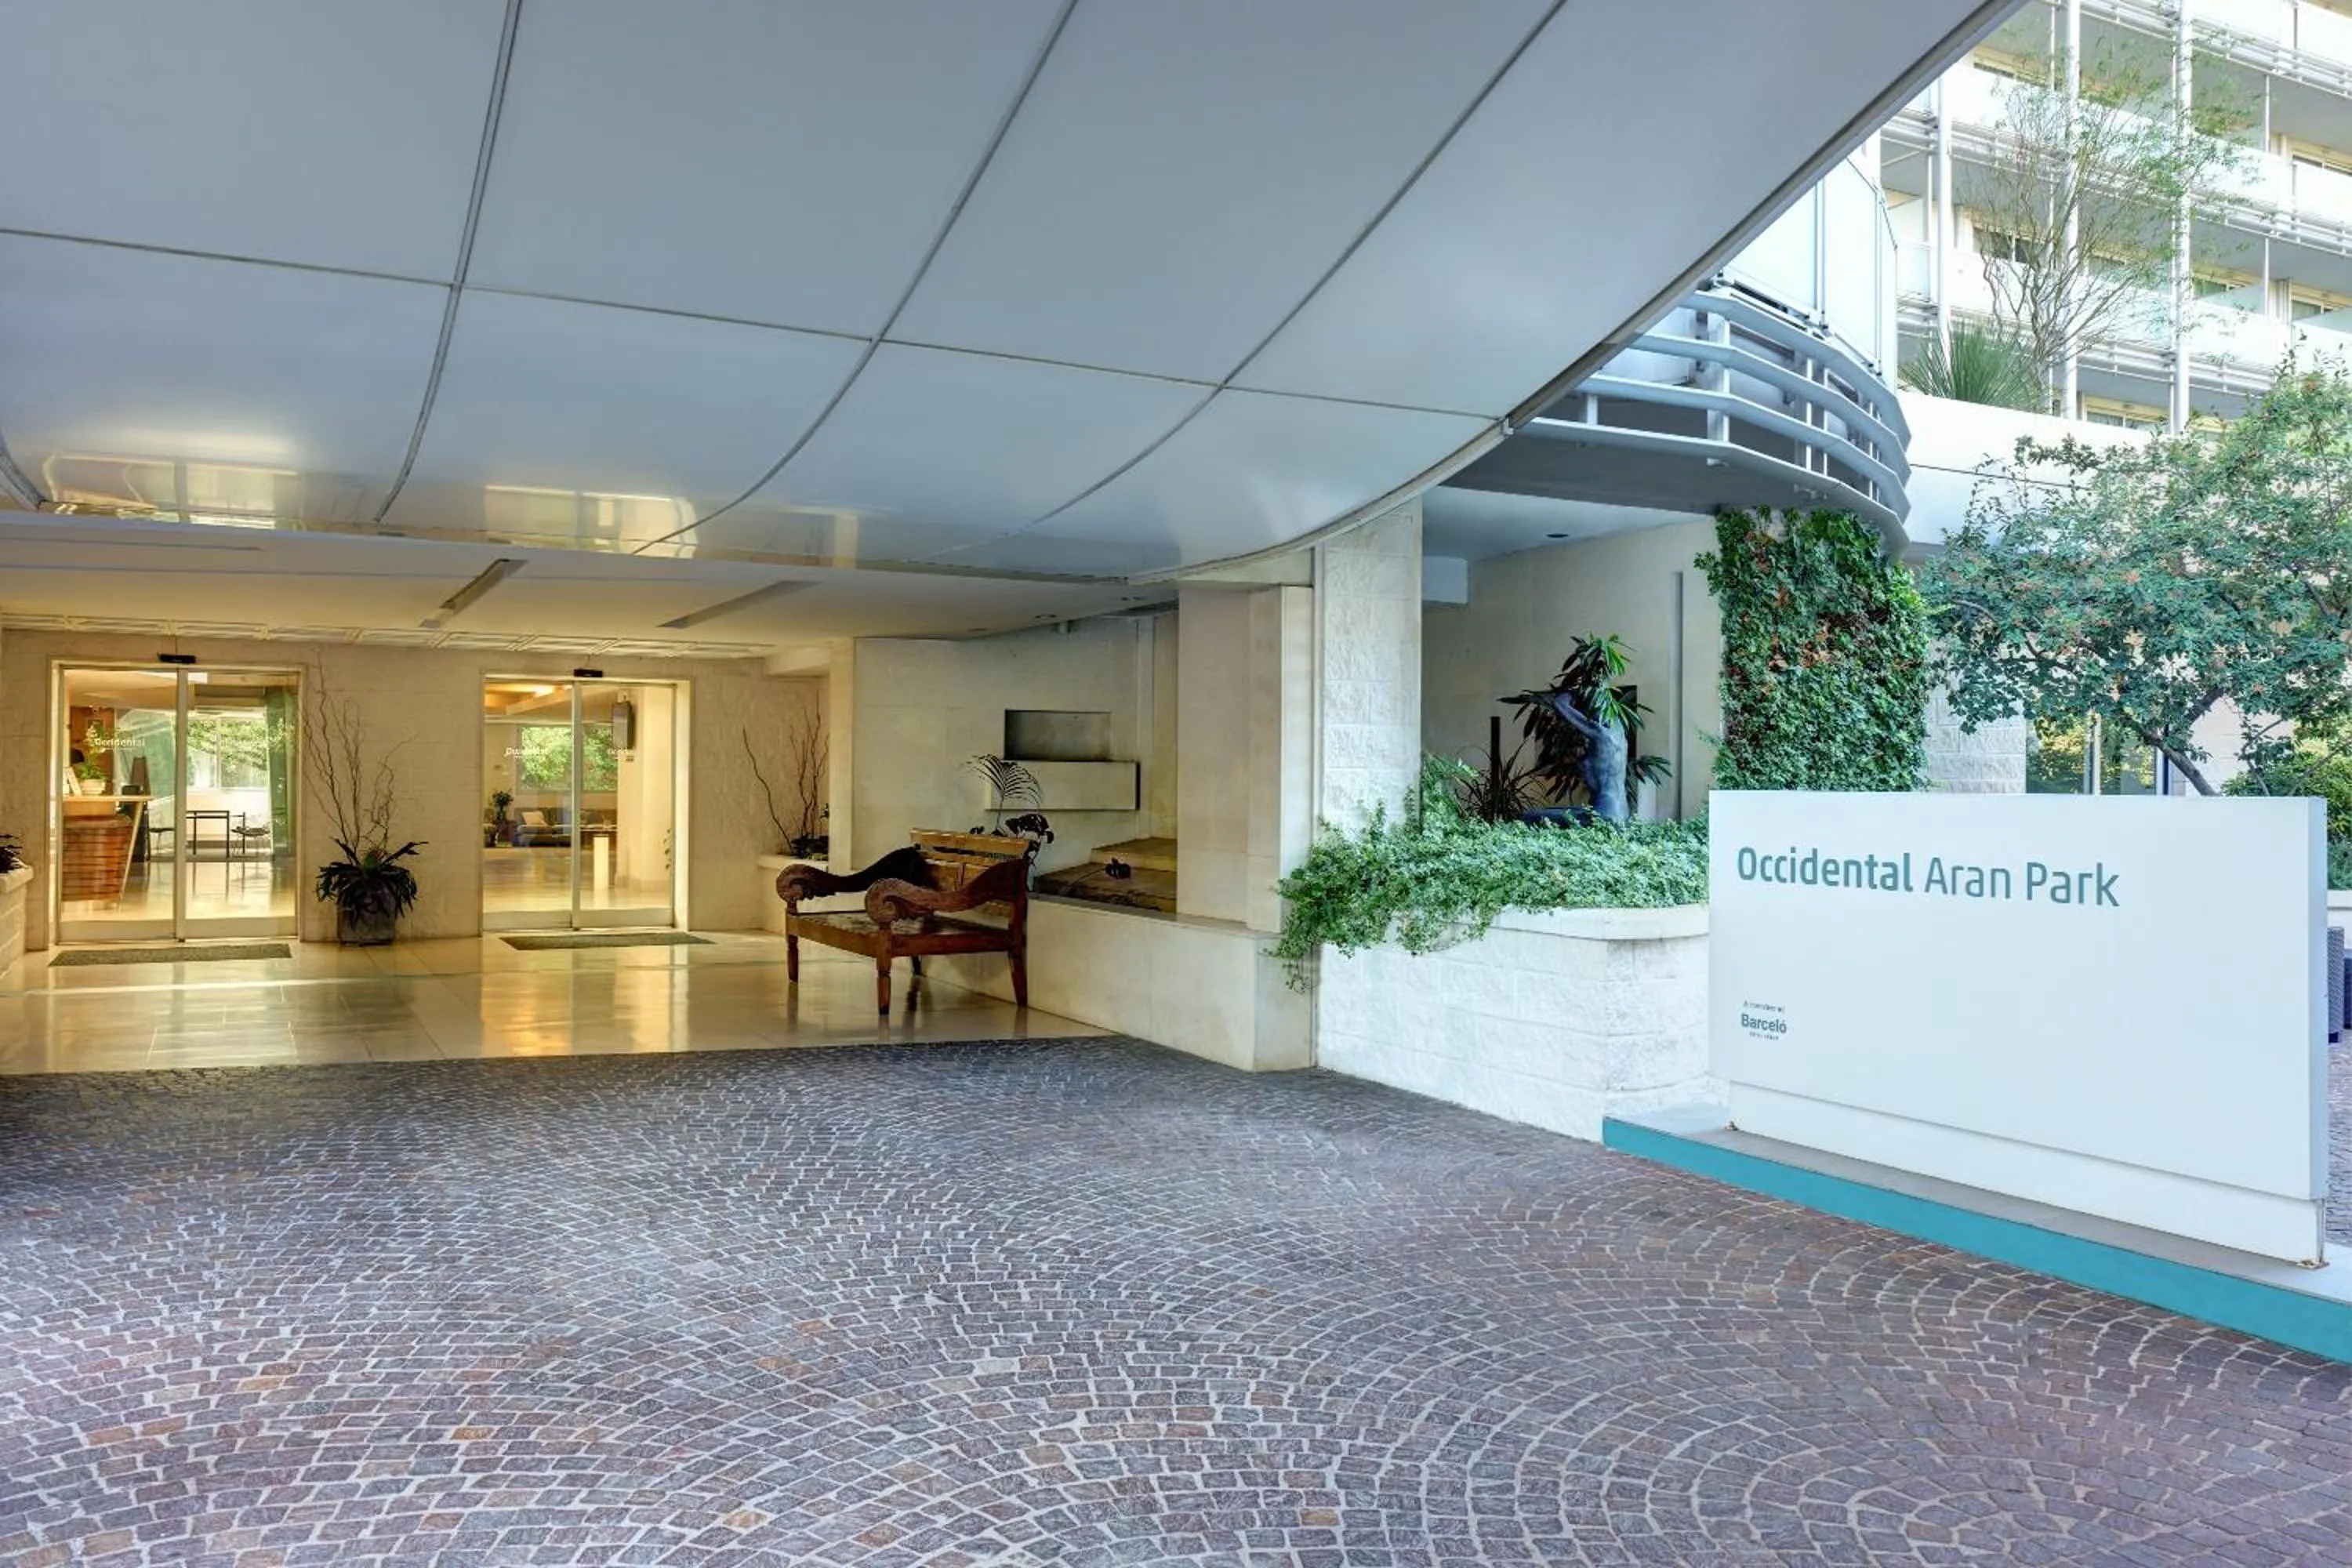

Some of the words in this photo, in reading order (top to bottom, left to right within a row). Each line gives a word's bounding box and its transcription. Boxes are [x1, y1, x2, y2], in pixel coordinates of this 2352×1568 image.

[1737, 846, 1914, 893] Occidental
[1924, 857, 2011, 899] Aran
[2027, 862, 2120, 907] Park
[1741, 1014, 1787, 1033] Barceló
